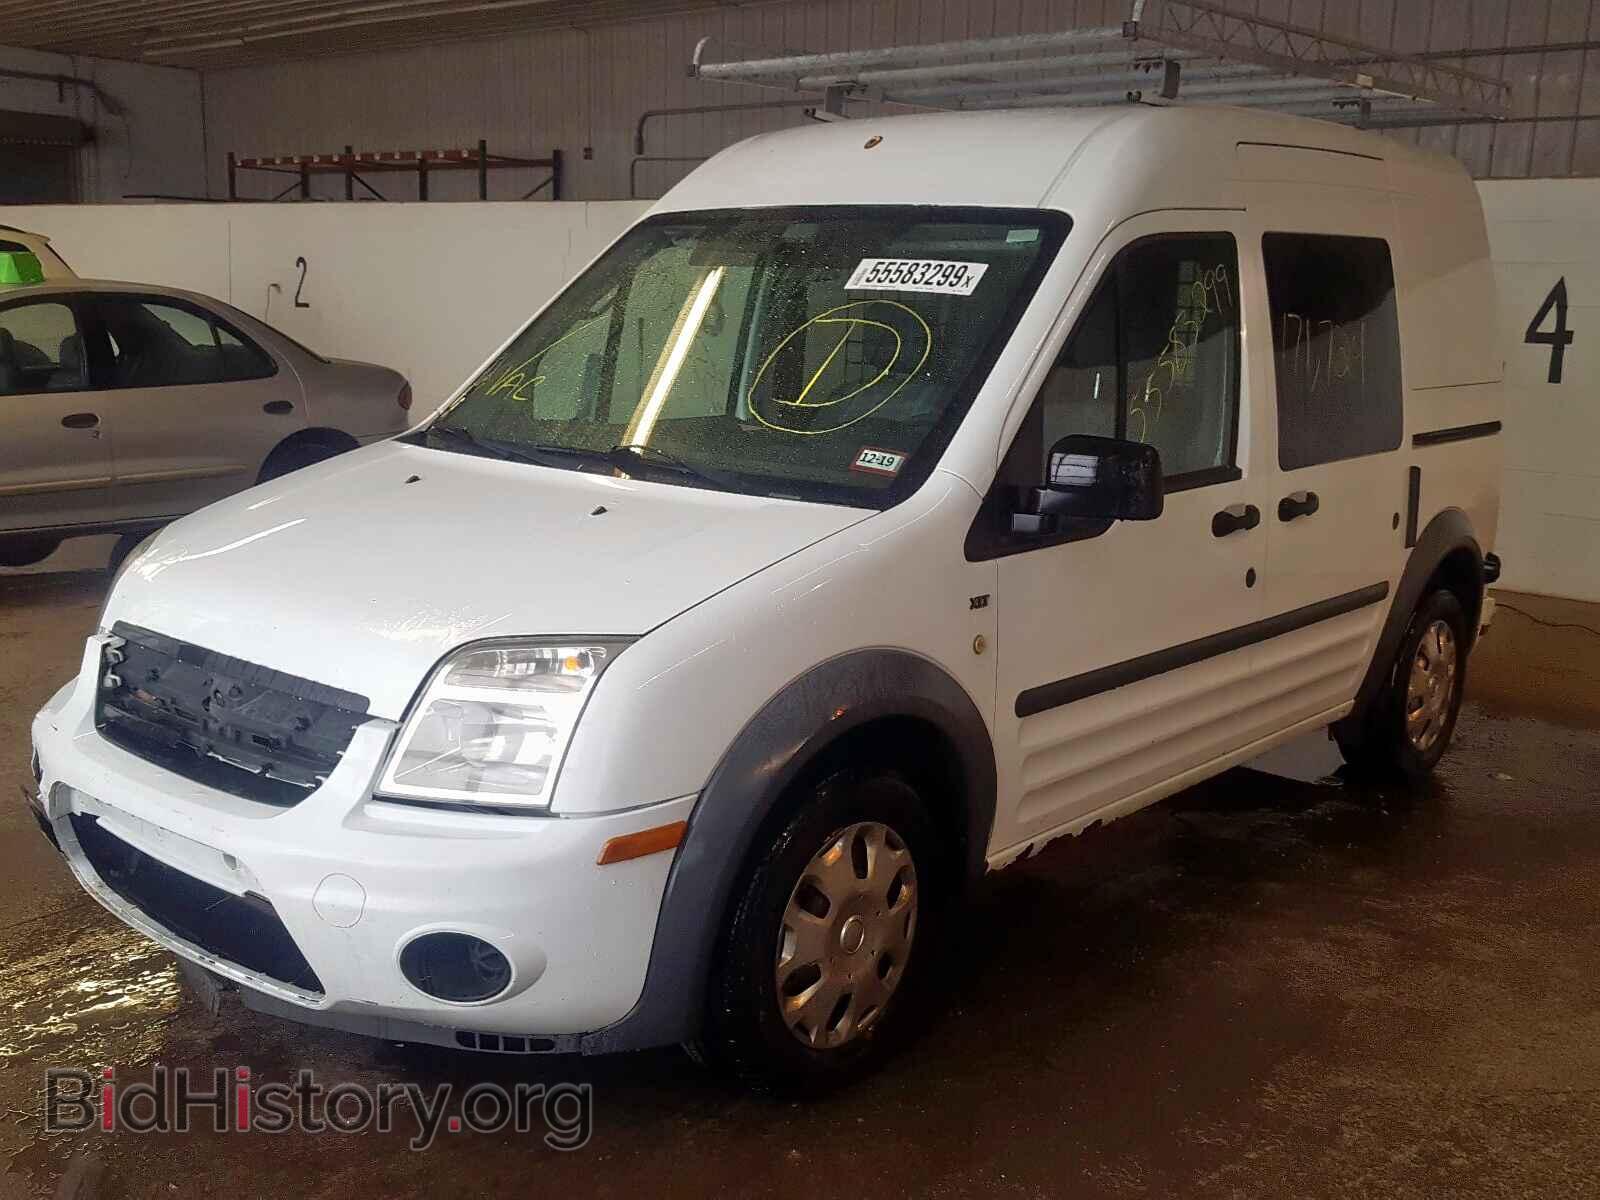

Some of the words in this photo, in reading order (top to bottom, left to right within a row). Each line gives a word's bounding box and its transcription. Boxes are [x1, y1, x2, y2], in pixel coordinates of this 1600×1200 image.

[295, 256, 309, 307] 2
[865, 261, 968, 287] 55583299
[1524, 276, 1574, 384] 4
[859, 452, 895, 467] 12-19
